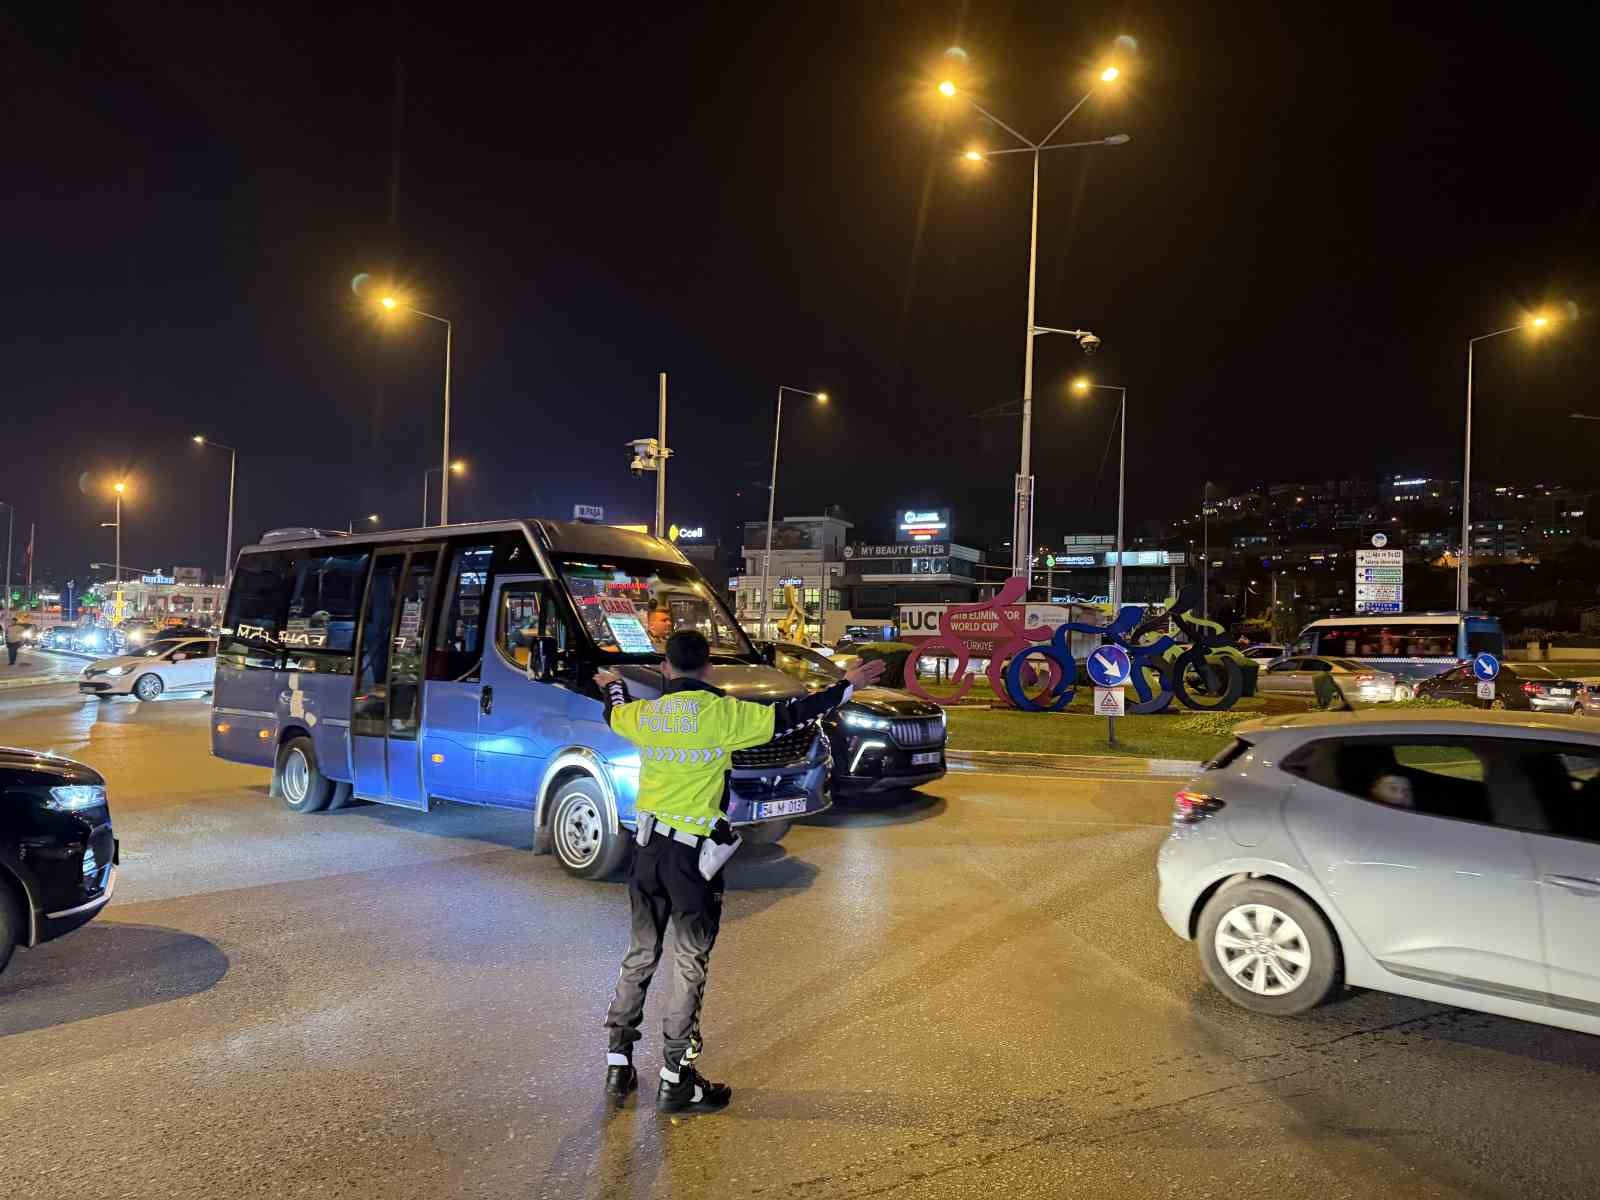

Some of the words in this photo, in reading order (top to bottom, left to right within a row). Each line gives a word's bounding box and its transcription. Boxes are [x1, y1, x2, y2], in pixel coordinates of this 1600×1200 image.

[861, 546, 874, 555] MY
[875, 545, 908, 555] BEAUTY
[910, 544, 944, 555] CENTER
[950, 622, 980, 631] WORLD
[981, 622, 999, 631] CUP
